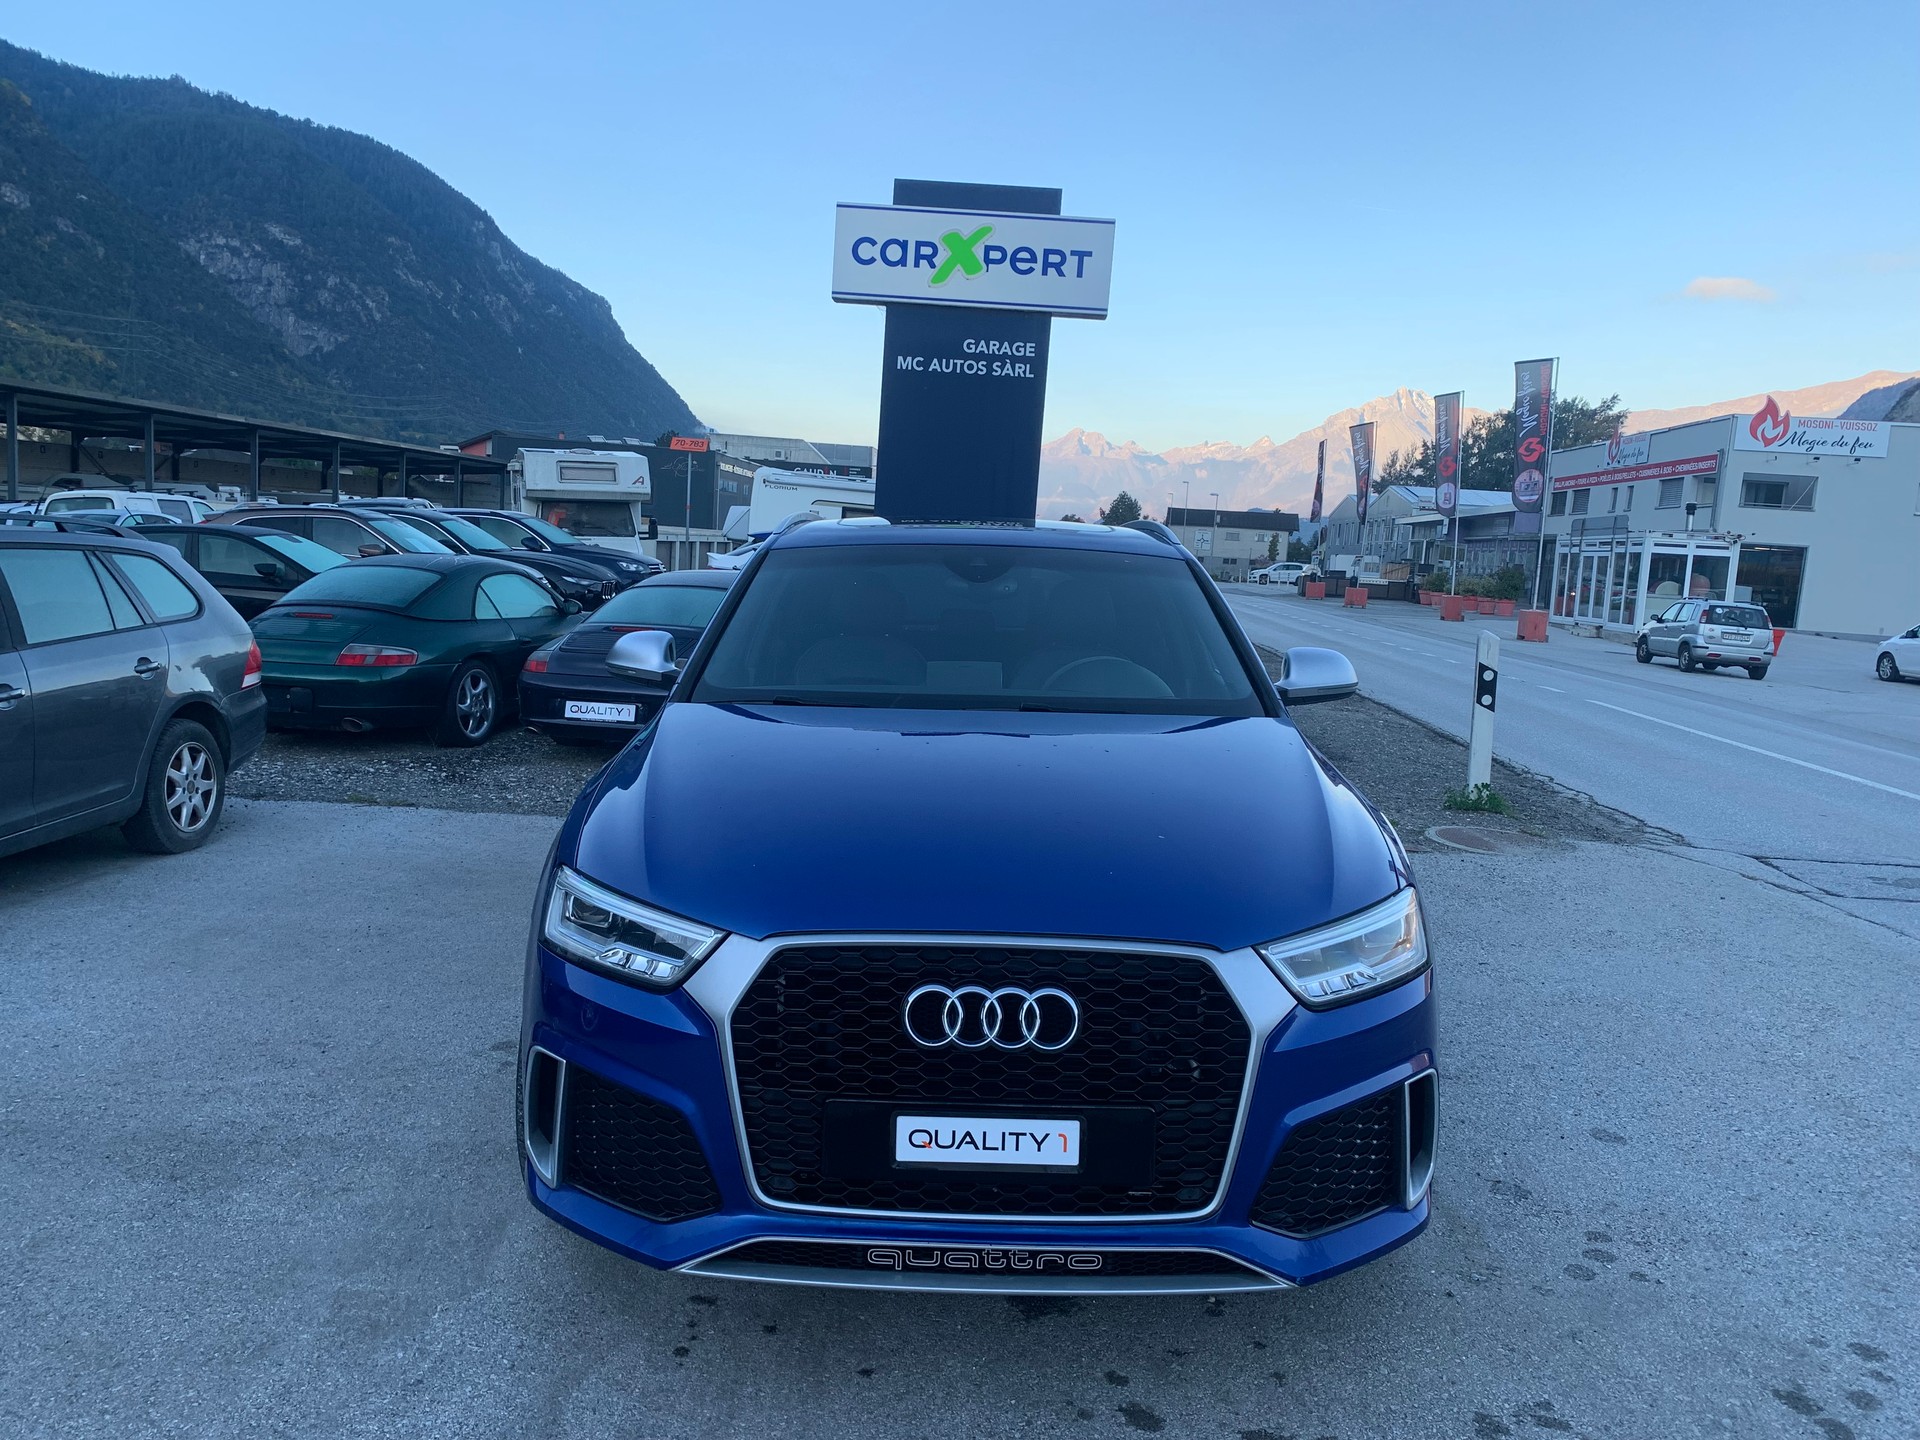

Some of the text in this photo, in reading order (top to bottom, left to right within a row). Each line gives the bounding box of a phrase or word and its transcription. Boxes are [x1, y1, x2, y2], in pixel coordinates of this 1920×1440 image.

[962, 338, 1036, 357] GARAGE
[896, 356, 1035, 378] MC AUTOS SÀRL
[1797, 419, 1879, 432] MOSONI-VUISSOZ
[674, 439, 704, 448] 70-783
[1778, 430, 1875, 454] Magie du feu
[569, 704, 624, 716] QUALITY
[908, 1129, 1068, 1153] QUALITY 1
[867, 1248, 1103, 1270] quattro
